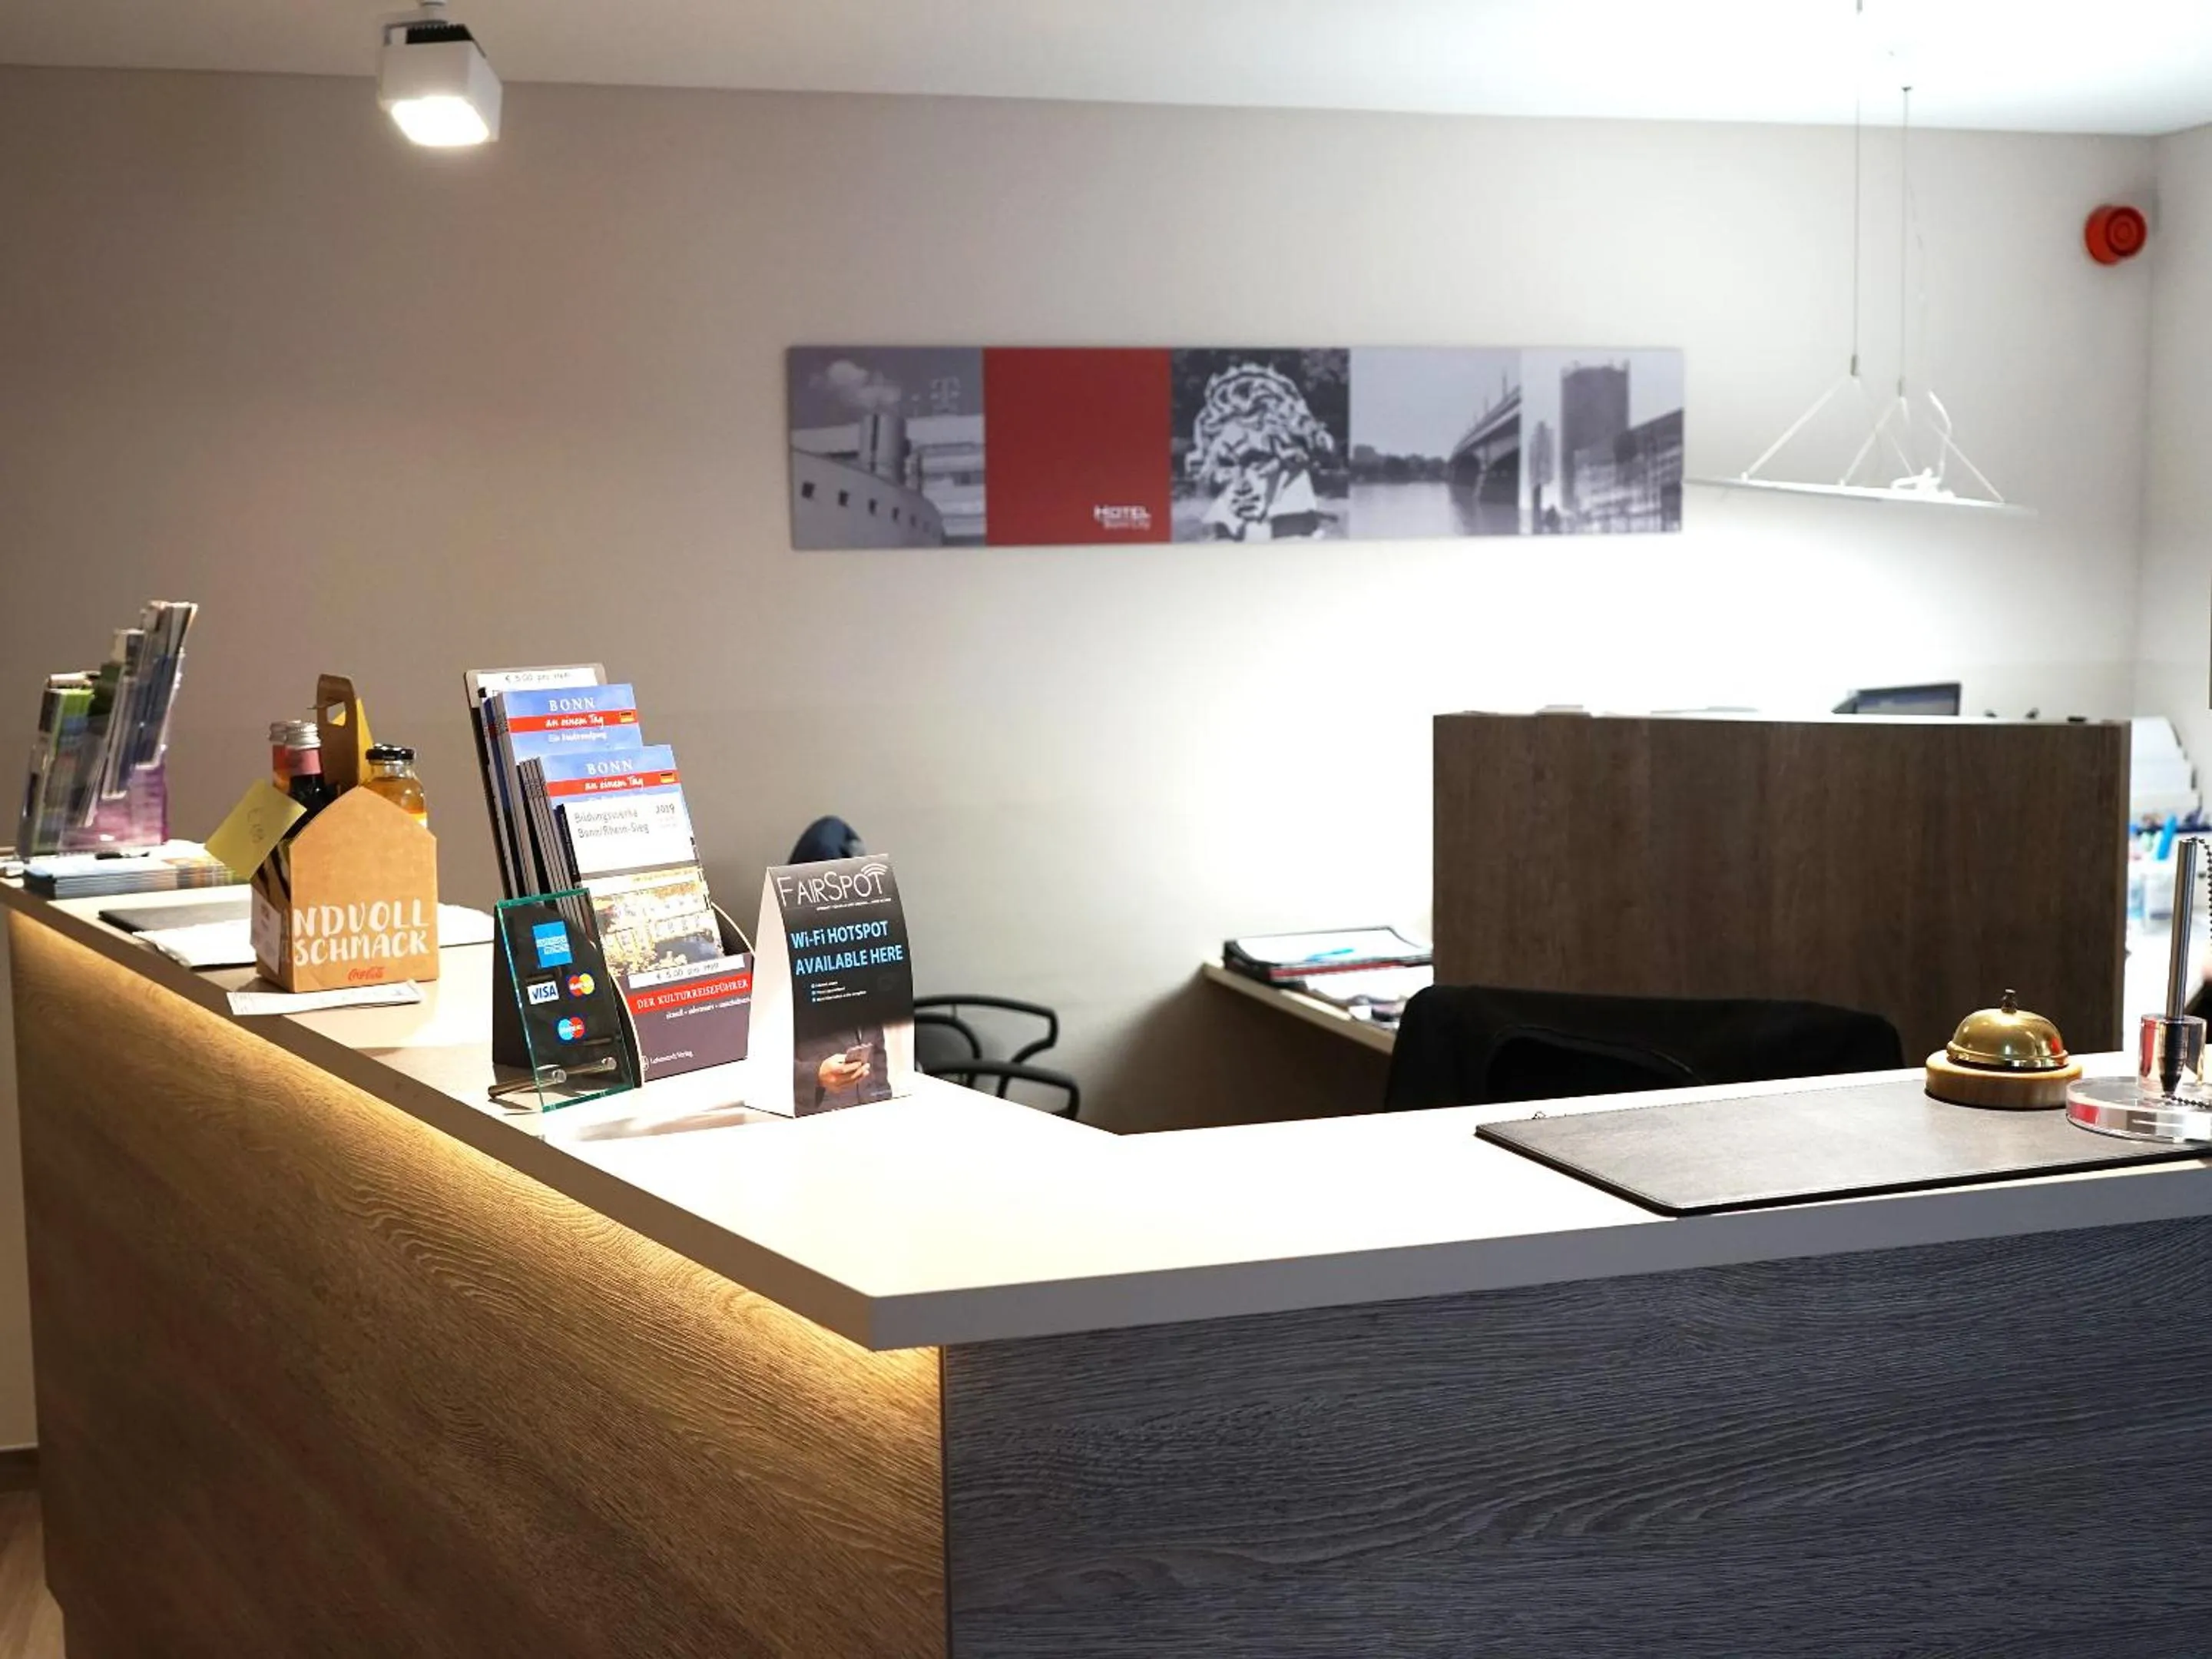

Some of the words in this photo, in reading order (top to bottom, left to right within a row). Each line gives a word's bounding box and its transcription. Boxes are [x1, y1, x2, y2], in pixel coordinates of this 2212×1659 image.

[548, 697, 594, 711] BONN
[545, 719, 558, 727] an
[561, 716, 587, 727] einem
[588, 714, 604, 730] Tag
[585, 759, 633, 775] BONN
[600, 779, 627, 790] einem
[627, 776, 644, 791] Tag
[656, 803, 675, 815] 2019
[293, 899, 430, 937] NDVOLL
[790, 929, 826, 949] Wi-Fi
[827, 920, 889, 944] HOTSPOT
[293, 930, 430, 967] SCHMACK
[796, 949, 868, 975] AVAILABLE
[870, 945, 904, 964] HERE
[531, 985, 557, 1000] VISA
[637, 998, 655, 1009] DER
[657, 979, 748, 1005] KULTURREISEFÜHRER
